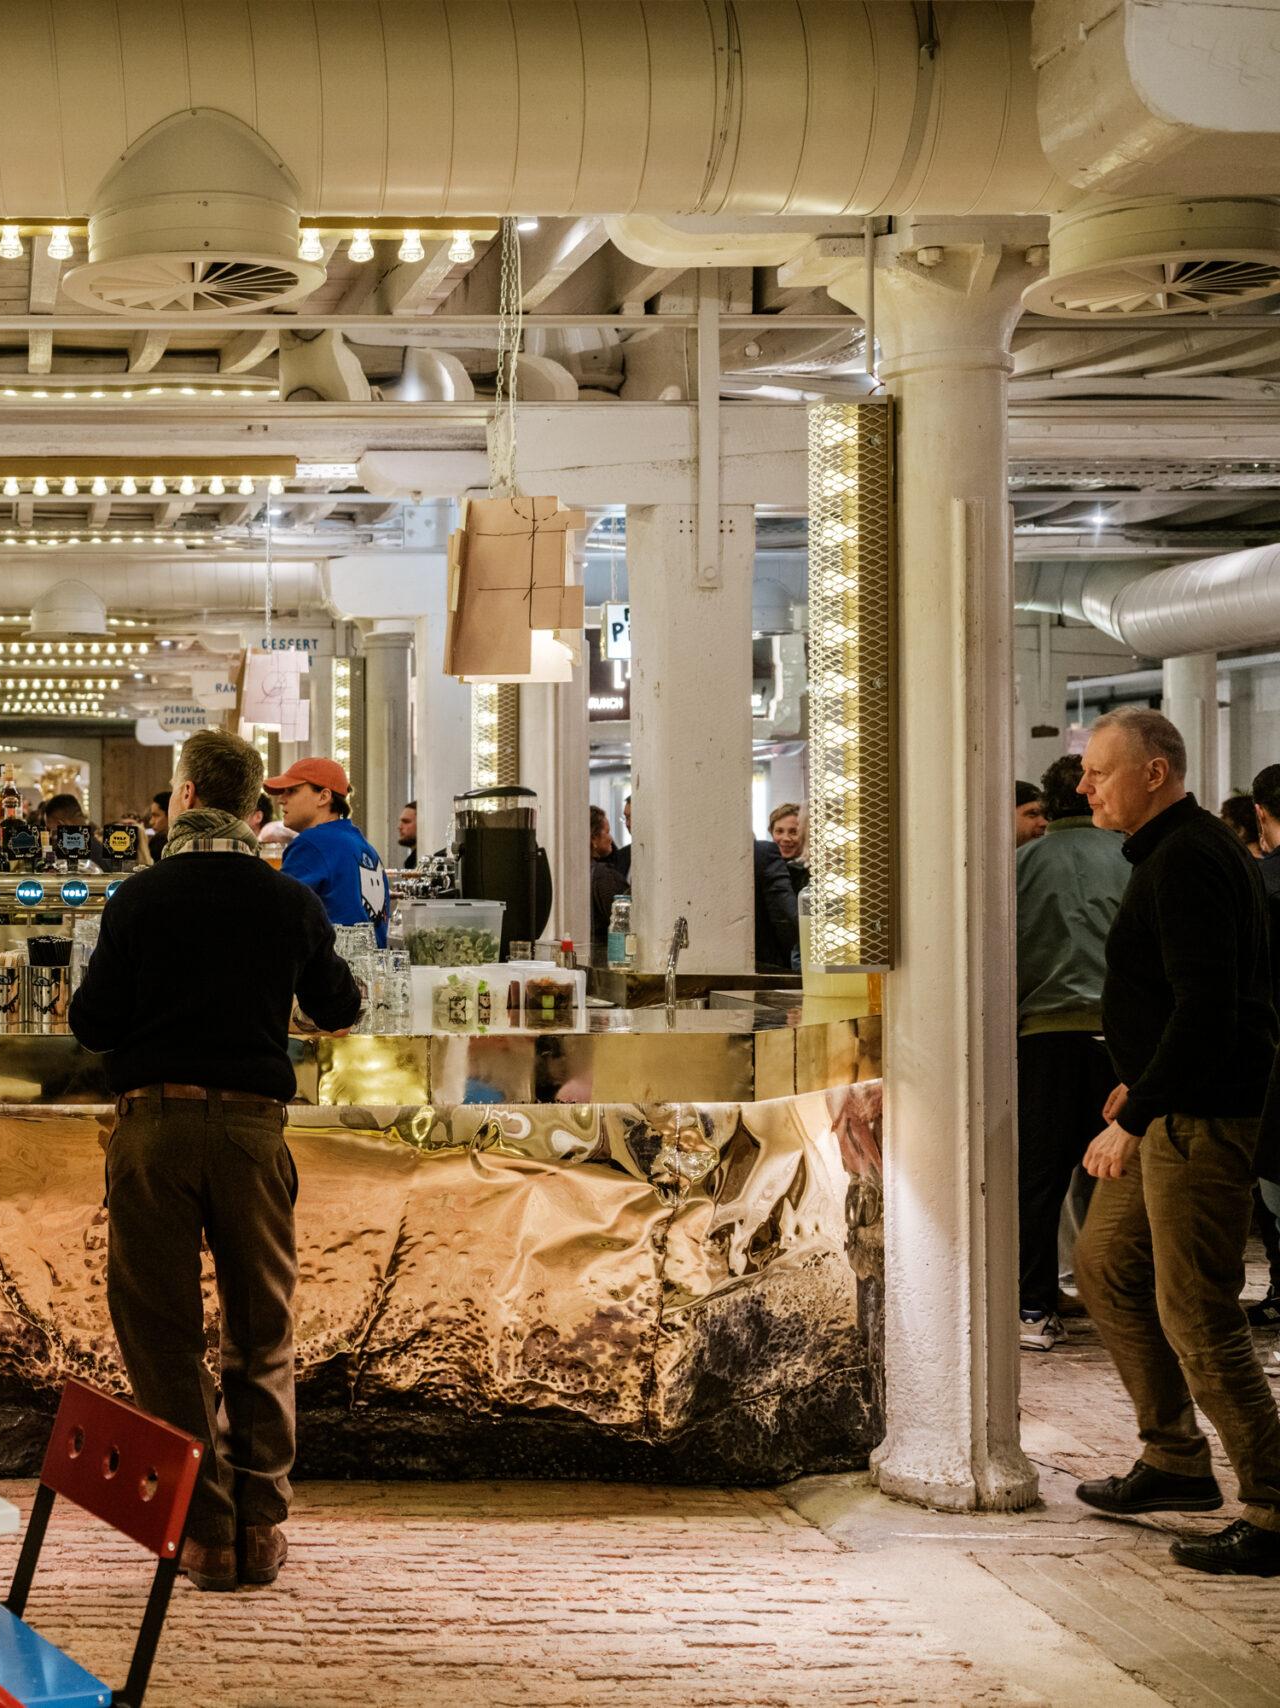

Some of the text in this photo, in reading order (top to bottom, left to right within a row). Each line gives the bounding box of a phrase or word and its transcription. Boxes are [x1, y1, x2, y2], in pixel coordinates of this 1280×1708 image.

[261, 638, 319, 650] DESSERT
[163, 717, 206, 725] JAPANESE
[18, 889, 42, 897] WOLF
[63, 889, 87, 897] WOLF
